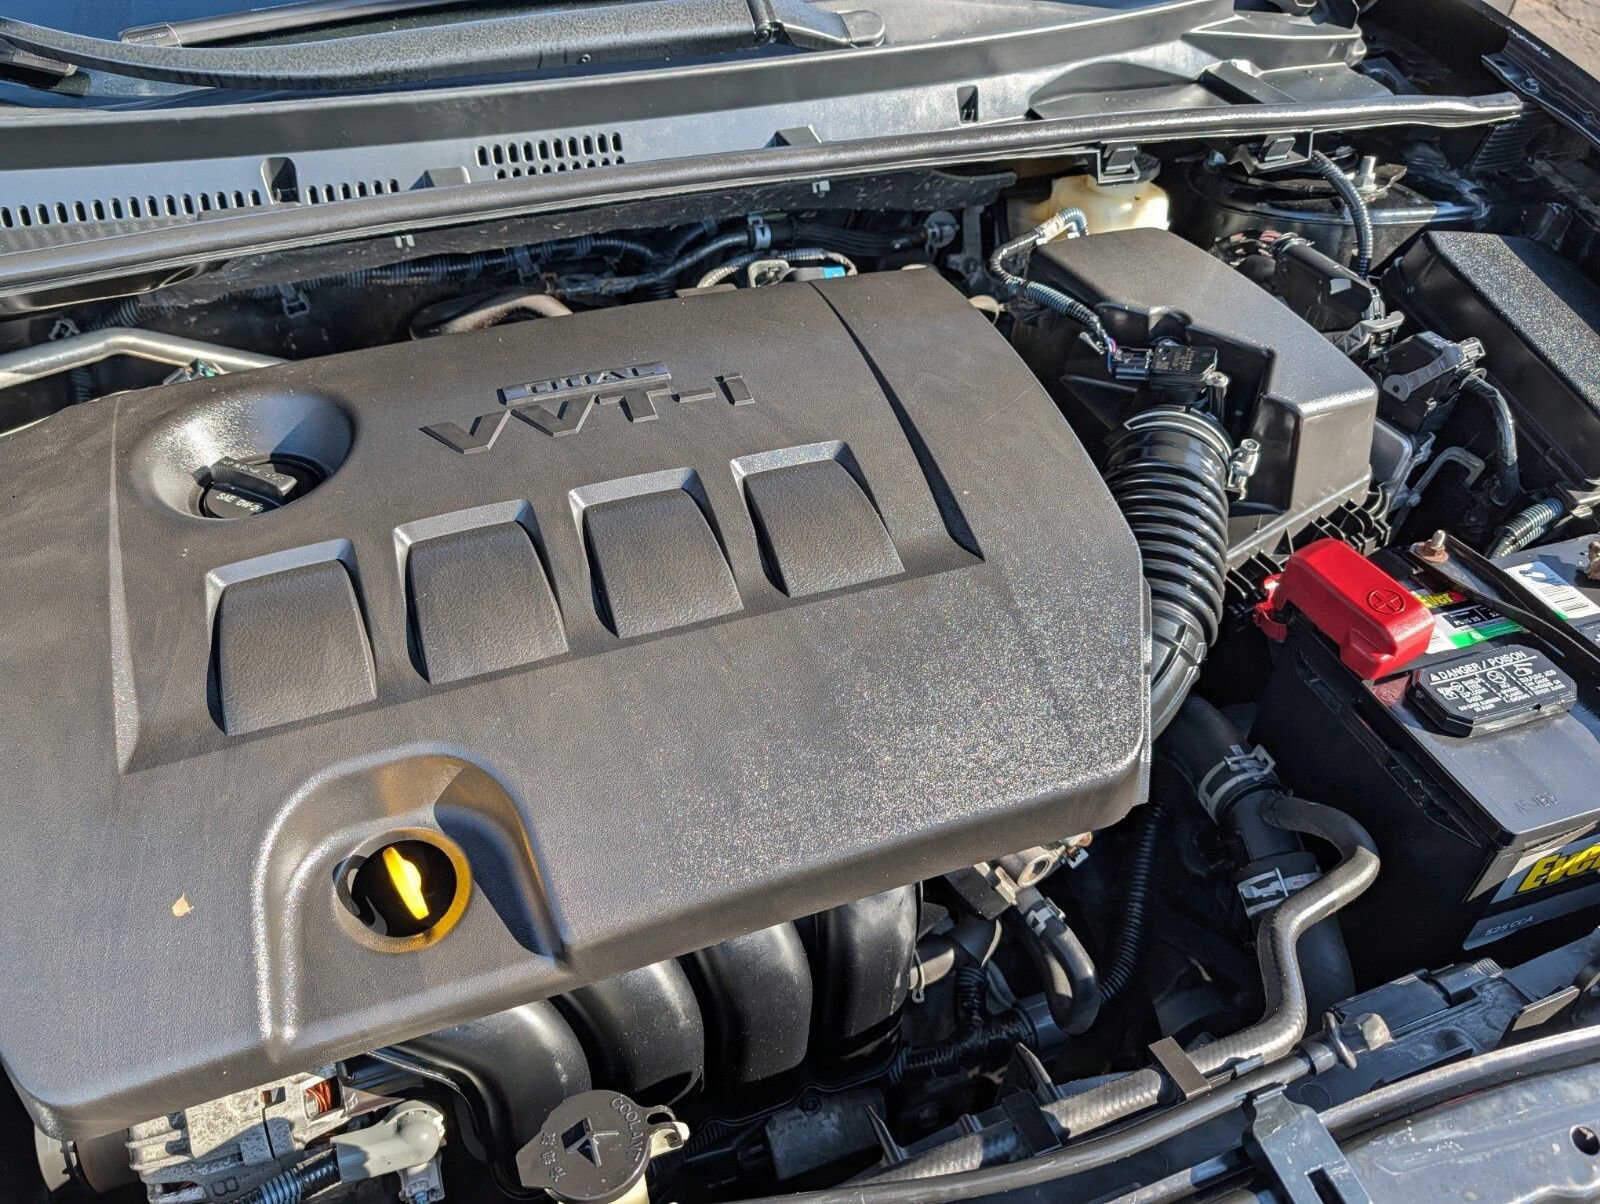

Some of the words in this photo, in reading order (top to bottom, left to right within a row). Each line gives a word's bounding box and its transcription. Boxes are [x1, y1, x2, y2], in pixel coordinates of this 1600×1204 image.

[216, 493, 237, 503] SAE
[236, 499, 264, 513] 0W-20
[1440, 663, 1482, 680] DANGER
[1490, 651, 1527, 666] POISON
[1485, 922, 1509, 936] 525
[1510, 915, 1534, 928] CCA
[610, 1097, 644, 1162] COOLANT
